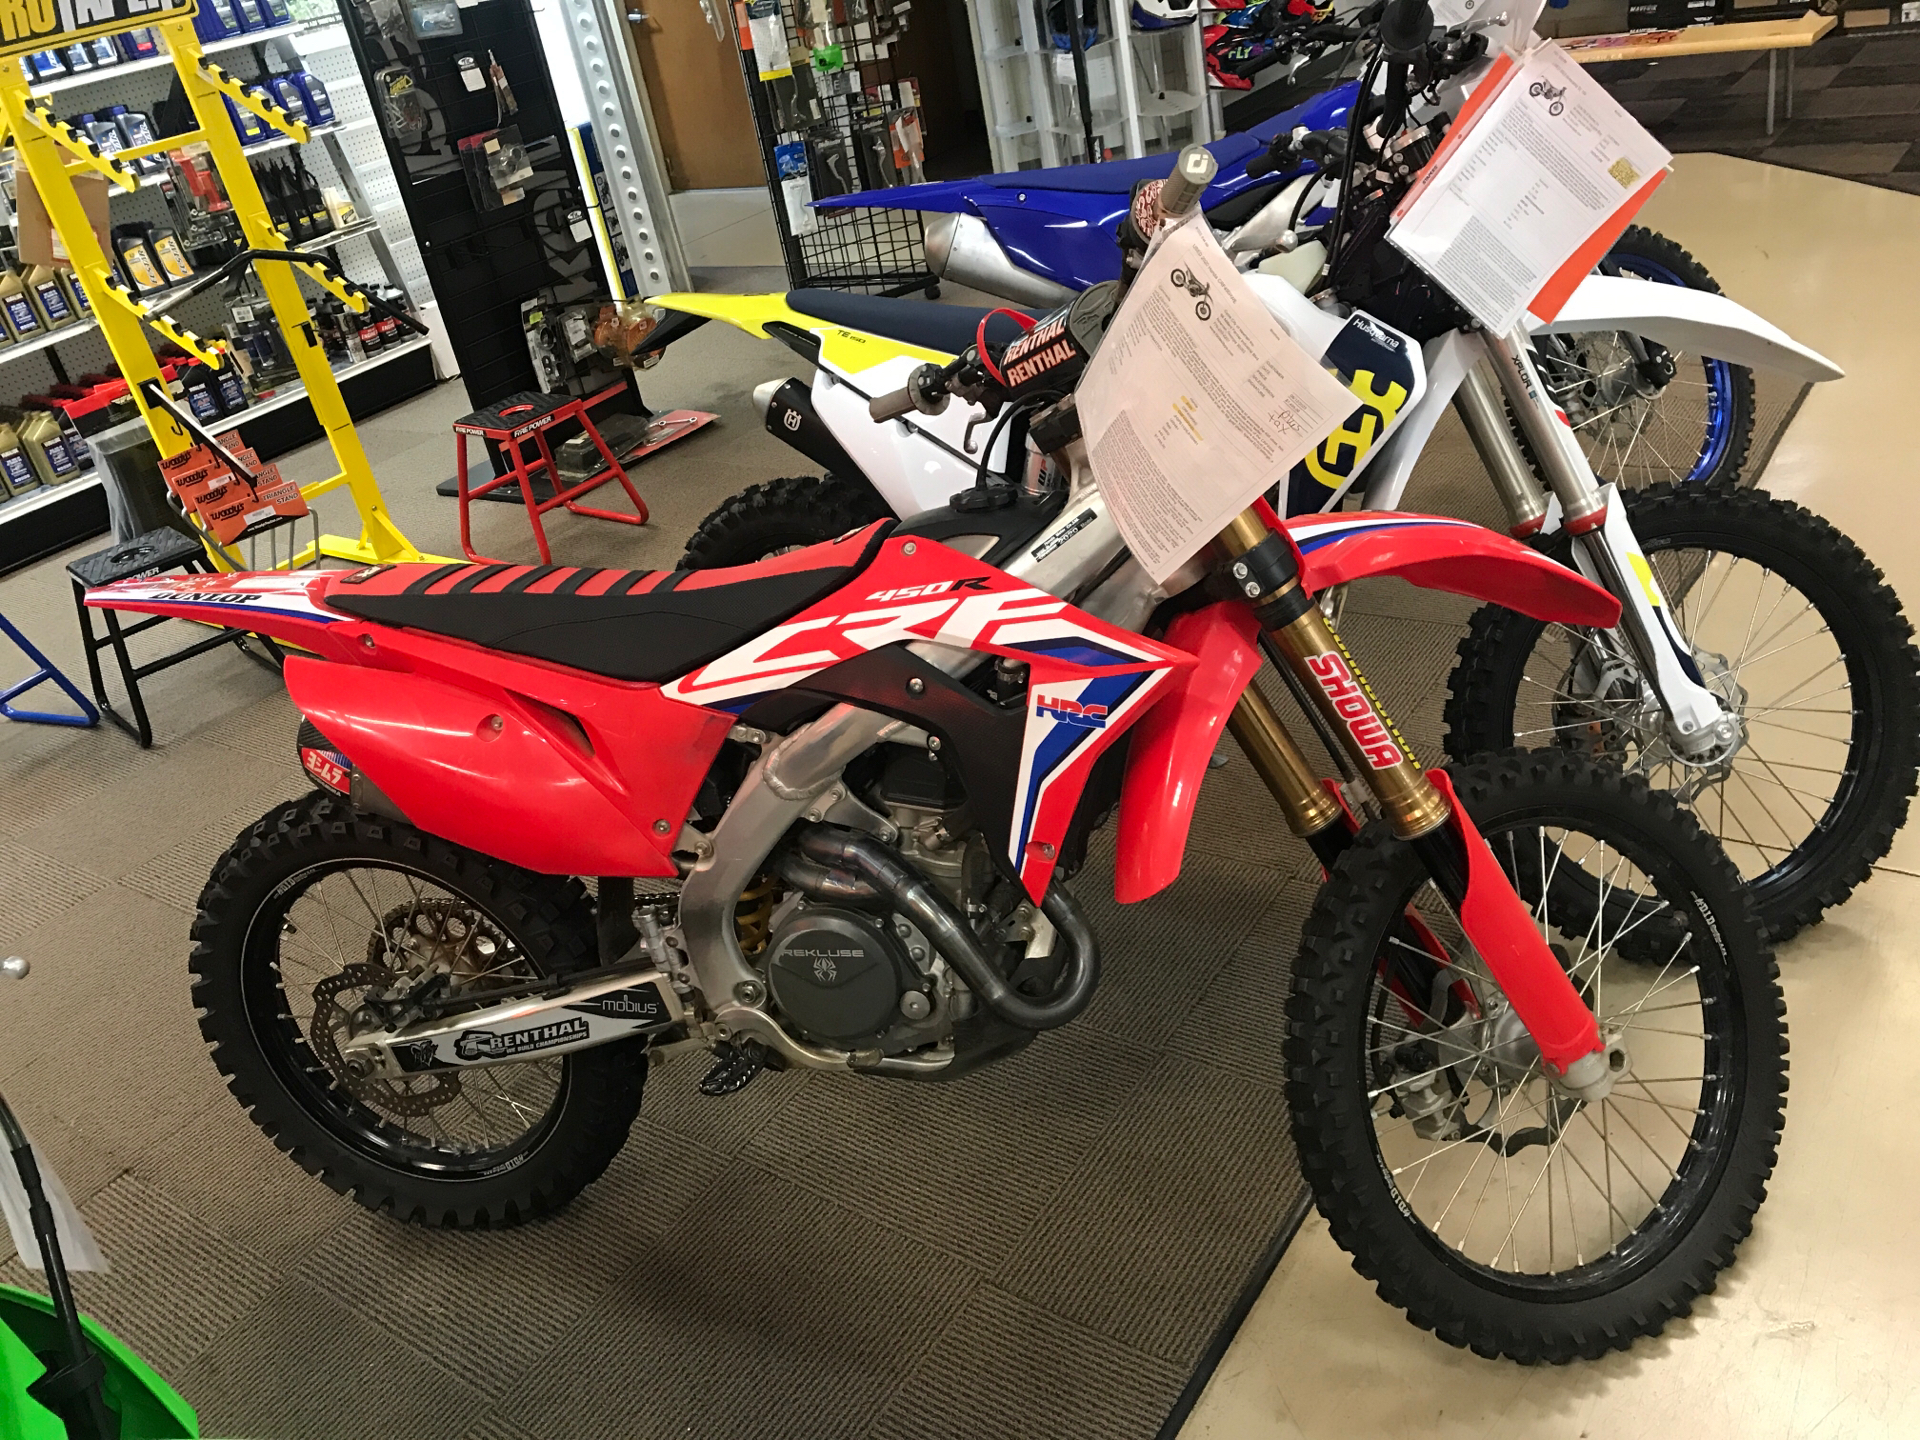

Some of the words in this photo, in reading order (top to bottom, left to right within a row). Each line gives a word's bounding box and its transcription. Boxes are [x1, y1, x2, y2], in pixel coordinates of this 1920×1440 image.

[837, 329, 851, 337] TE
[1003, 316, 1065, 366] RENTHAL
[1007, 339, 1077, 388] RENTHAL
[1511, 354, 1532, 389] XPLOR
[466, 428, 484, 436] POWER
[529, 415, 552, 431] POWER
[1267, 413, 1288, 435] tax
[263, 485, 294, 501] TRIANGLE
[276, 493, 299, 504] STAND
[1059, 527, 1078, 545] 2020
[149, 592, 262, 604] DUNLOP
[865, 576, 991, 602] 450R
[690, 588, 1069, 687] CRF
[1036, 694, 1108, 729] HRC
[1304, 651, 1403, 770] SHOWA
[307, 751, 342, 785] ヨシムラ
[781, 949, 865, 958] REKLUSE
[602, 994, 658, 1015] mobius
[490, 1020, 587, 1049] RENTHAL
[535, 1032, 587, 1049] CHAMPIONSHIPS
